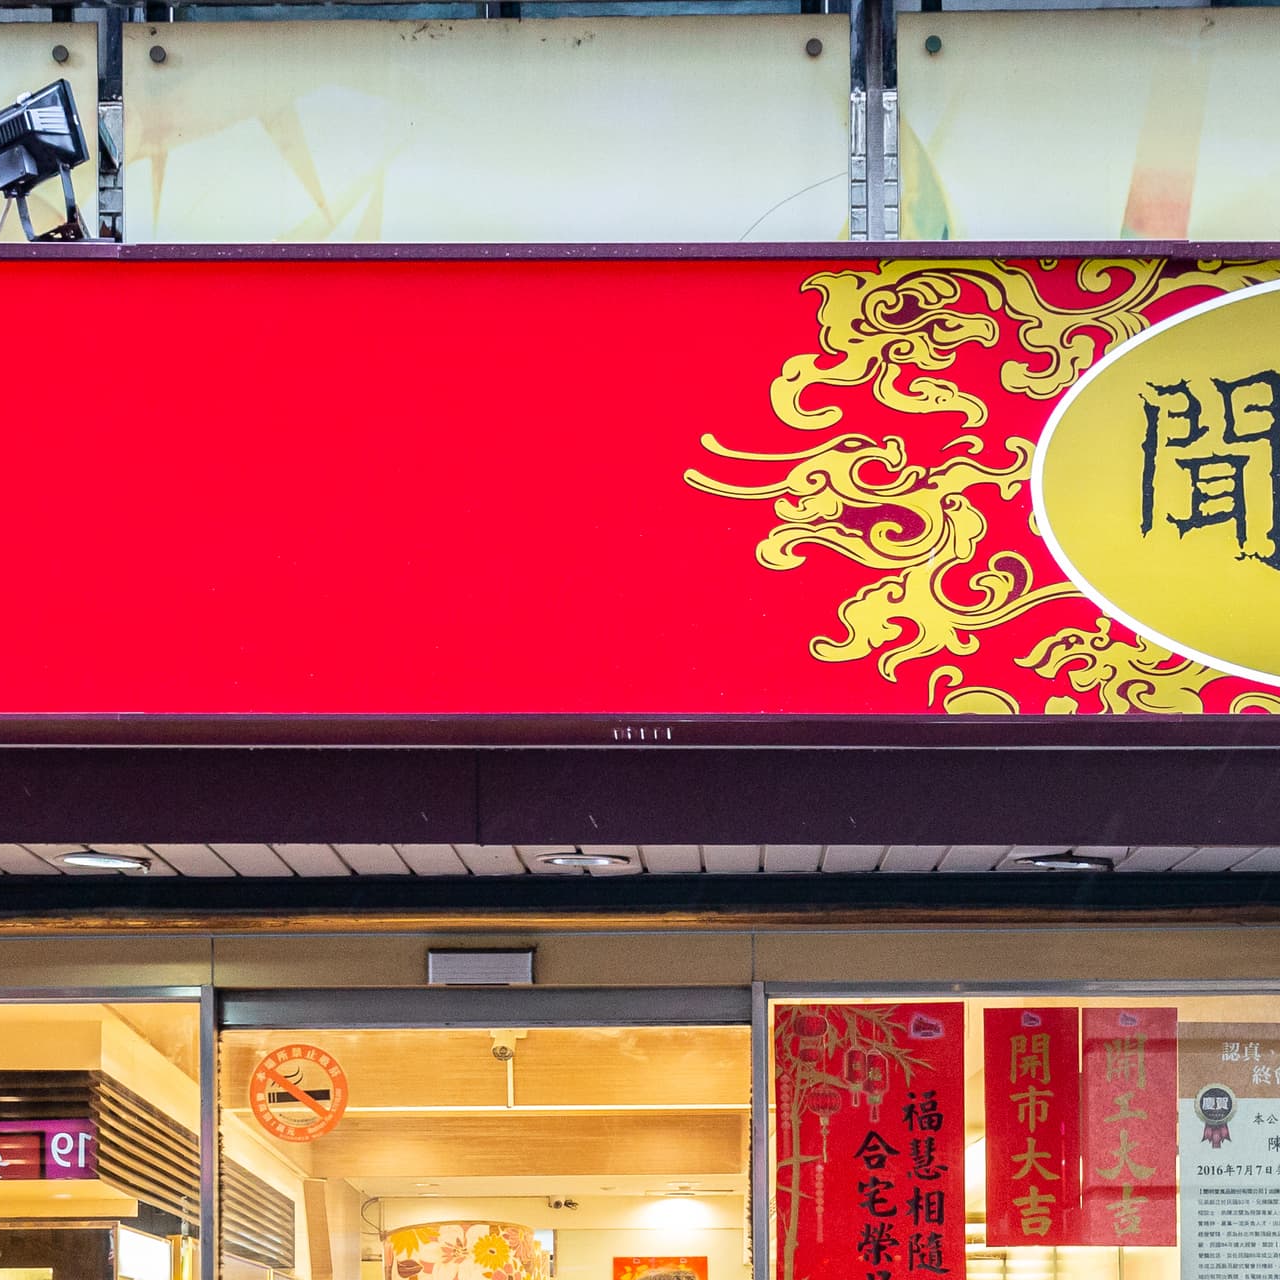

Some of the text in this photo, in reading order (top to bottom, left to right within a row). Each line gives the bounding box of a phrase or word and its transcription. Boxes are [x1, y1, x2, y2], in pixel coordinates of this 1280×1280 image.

[902, 1090, 950, 1275] 福慧相隨
[1009, 1032, 1060, 1237] 開市大吉
[1095, 1031, 1156, 1238] 開工大吉
